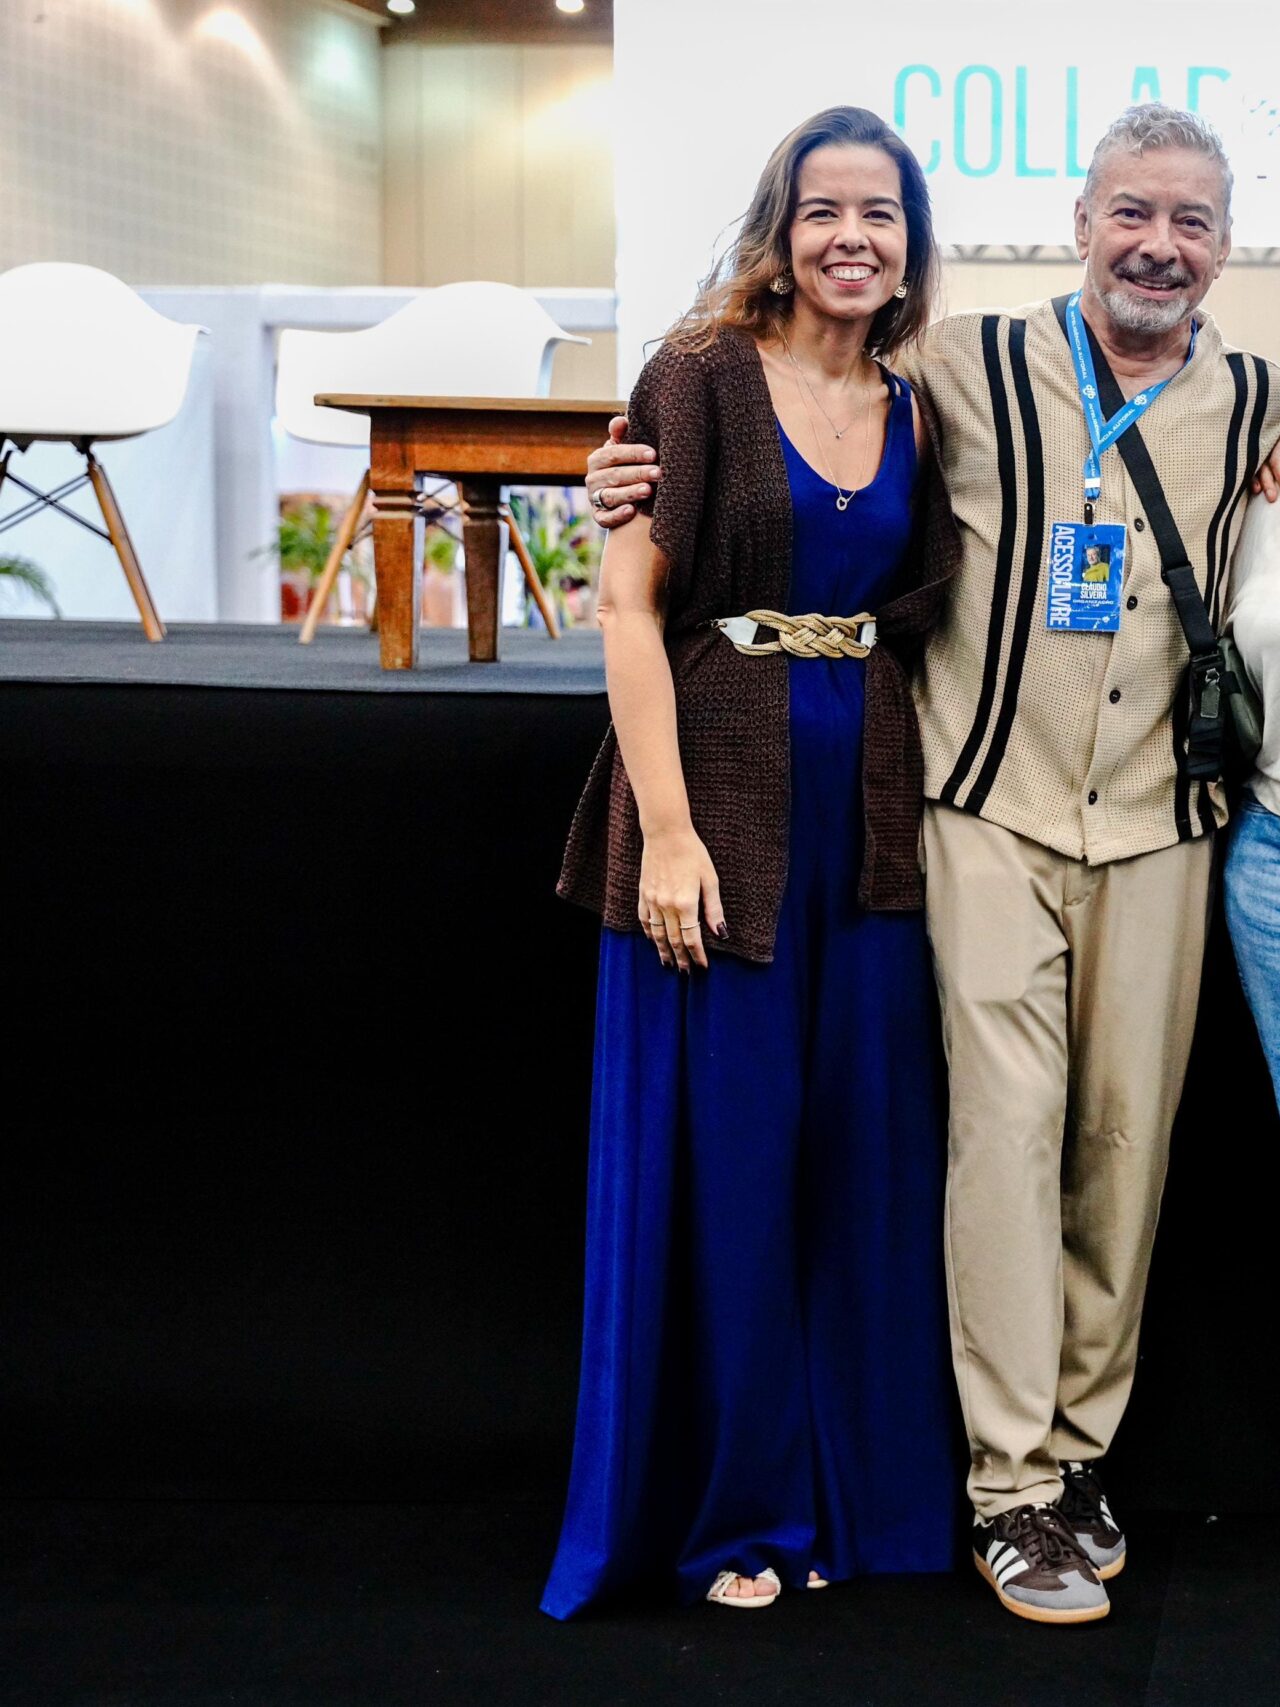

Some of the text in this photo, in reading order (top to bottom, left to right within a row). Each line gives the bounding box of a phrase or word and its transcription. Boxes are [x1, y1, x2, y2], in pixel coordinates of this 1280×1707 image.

[1078, 351, 1088, 379] AUTORAL
[1112, 408, 1136, 431] AUTORAL
[1050, 525, 1075, 627] ACESSO LIVRE
[1080, 591, 1107, 600] SILVEIRA
